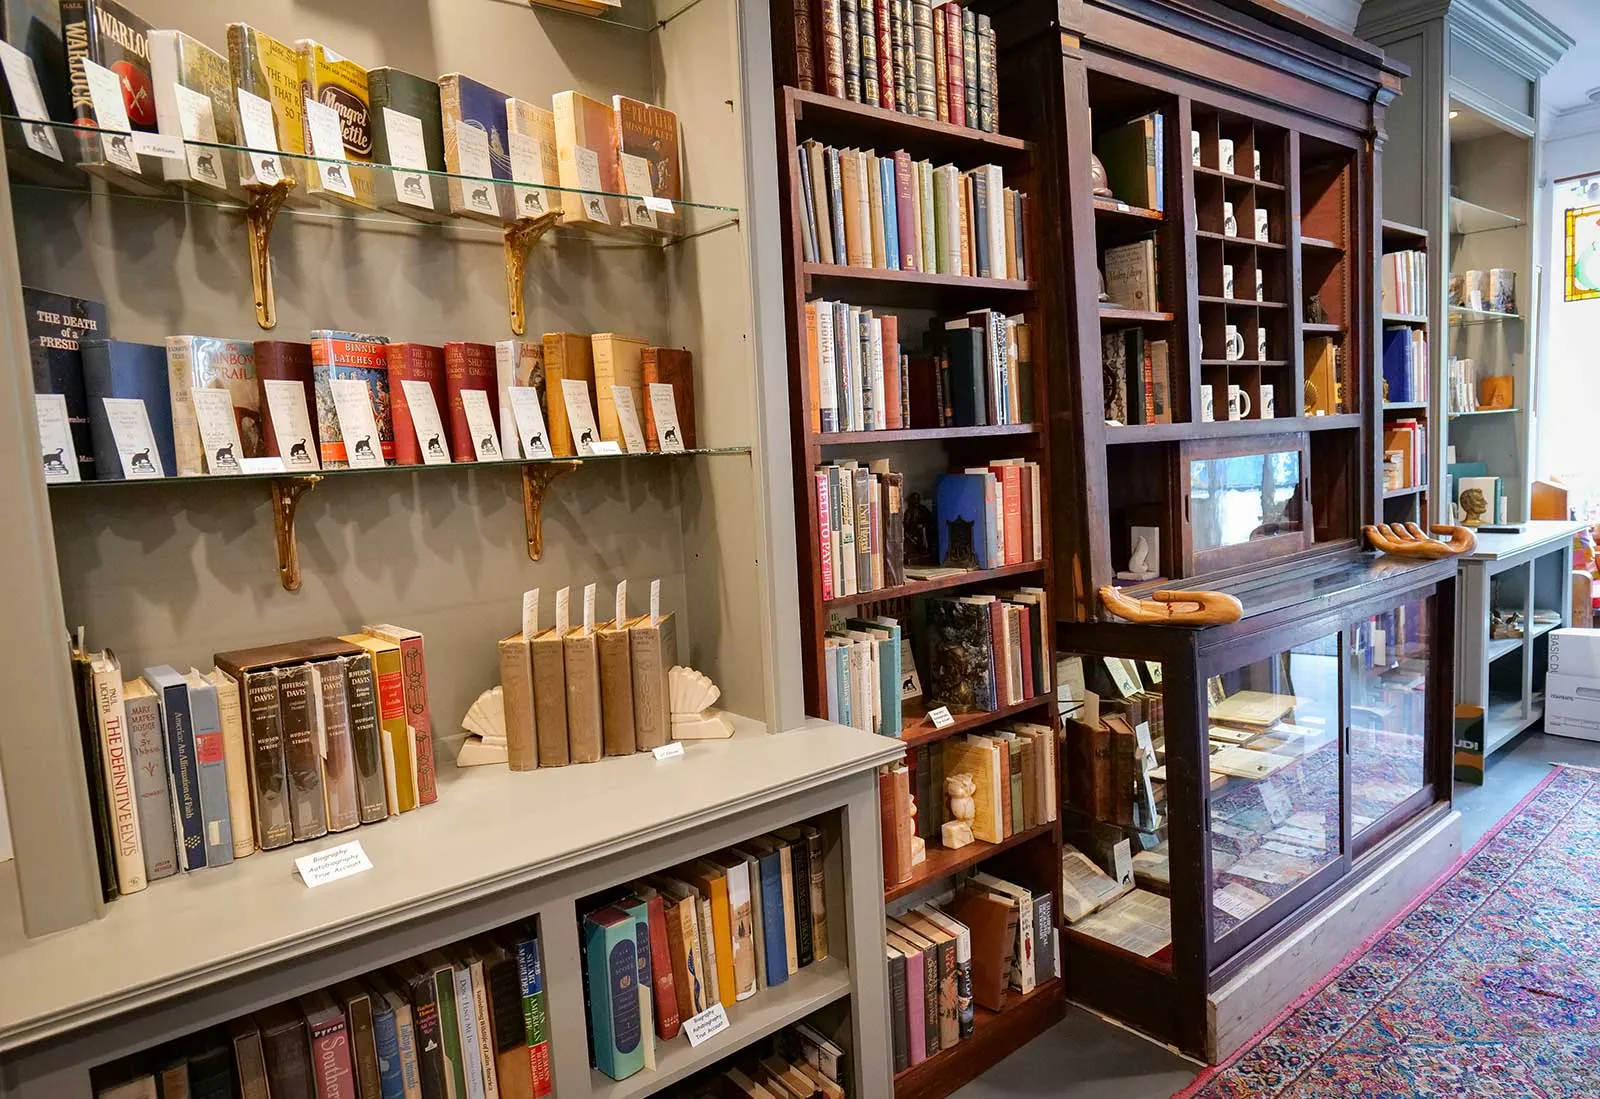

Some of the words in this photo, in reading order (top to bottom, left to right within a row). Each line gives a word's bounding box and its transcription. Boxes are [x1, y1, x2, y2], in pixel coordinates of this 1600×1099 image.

[265, 65, 281, 82] THE
[273, 85, 292, 103] THAT
[285, 106, 295, 119] SO
[324, 90, 367, 127] Mongrel
[37, 310, 61, 325] THE
[63, 314, 97, 331] DEATH
[61, 327, 71, 339] of
[71, 330, 79, 339] a
[39, 335, 80, 351] PRESID
[345, 342, 377, 354] BINNIE
[211, 352, 254, 366] AINBOW
[334, 354, 373, 366] LATCHES
[375, 358, 387, 367] ON
[818, 478, 829, 518] HELL
[820, 521, 830, 539] TO
[822, 541, 832, 568] PAY
[1550, 634, 1560, 662] BASIC
[248, 684, 278, 696] JEFFERSON
[281, 680, 309, 691] JEFFERSON
[323, 683, 343, 691] DAVIS
[351, 677, 370, 686] DAVIS
[100, 682, 111, 714] LICHTER
[254, 693, 275, 703] DAVIS
[286, 688, 306, 698] DAVIS
[131, 704, 151, 715] MARY
[131, 714, 155, 723] MAPES
[106, 718, 121, 746] THE
[109, 747, 132, 823] DEFINITIVE
[120, 822, 136, 858] ELVIS
[308, 854, 359, 874] Autobiography
[313, 848, 349, 864] Biography
[314, 871, 331, 880] True
[334, 860, 362, 873] Account
[519, 948, 530, 996] MAGRUDER
[526, 953, 536, 985] STUART
[476, 990, 484, 1021] Vanishing
[524, 1012, 533, 1031] LIFE
[530, 997, 543, 1042] AMERICAN
[479, 1020, 487, 1045] Wildlife
[486, 1066, 494, 1091] America
